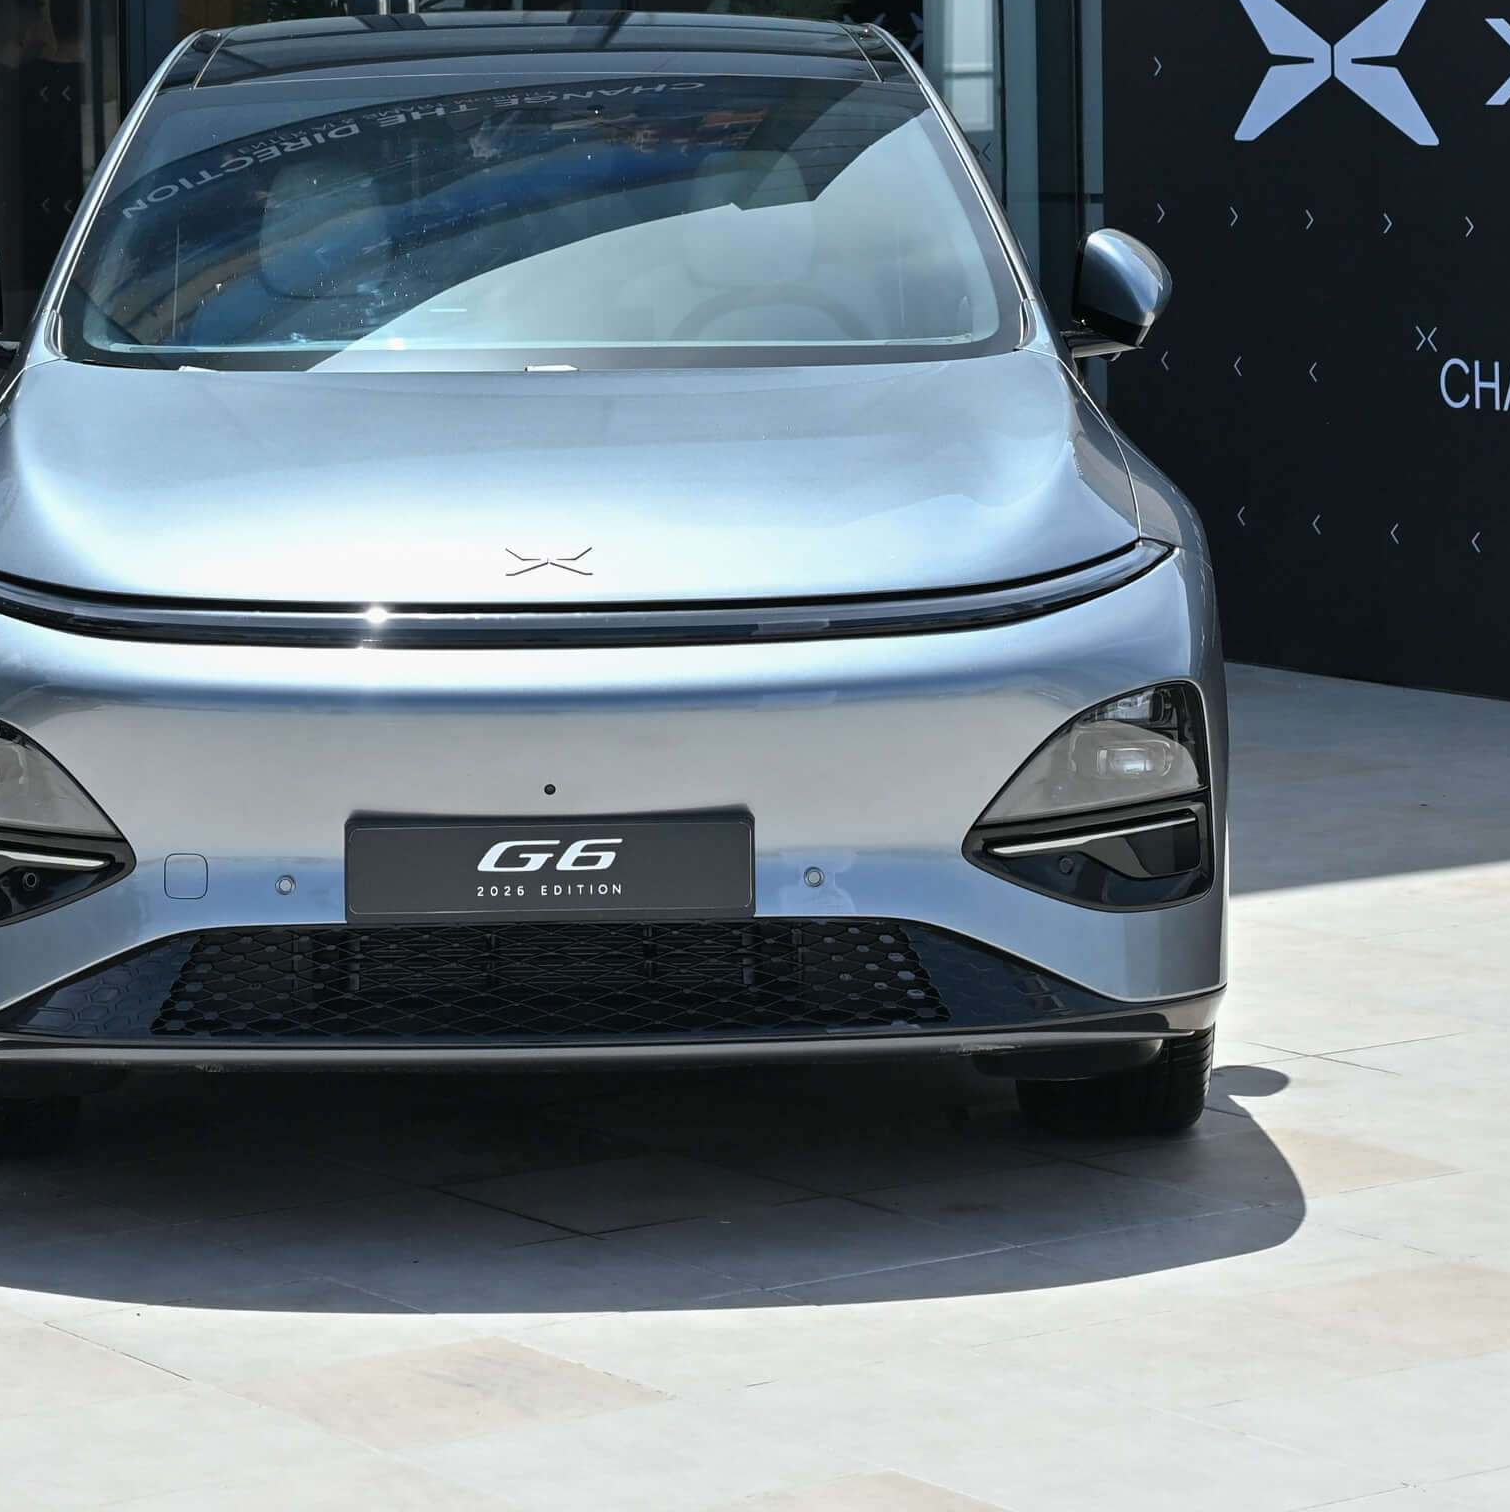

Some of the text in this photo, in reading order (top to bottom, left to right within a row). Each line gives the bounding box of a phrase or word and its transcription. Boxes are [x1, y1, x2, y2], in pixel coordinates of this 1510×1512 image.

[122, 121, 362, 220] DIRECTION
[477, 838, 623, 872] G6
[477, 883, 623, 897] 2026 EDITION
